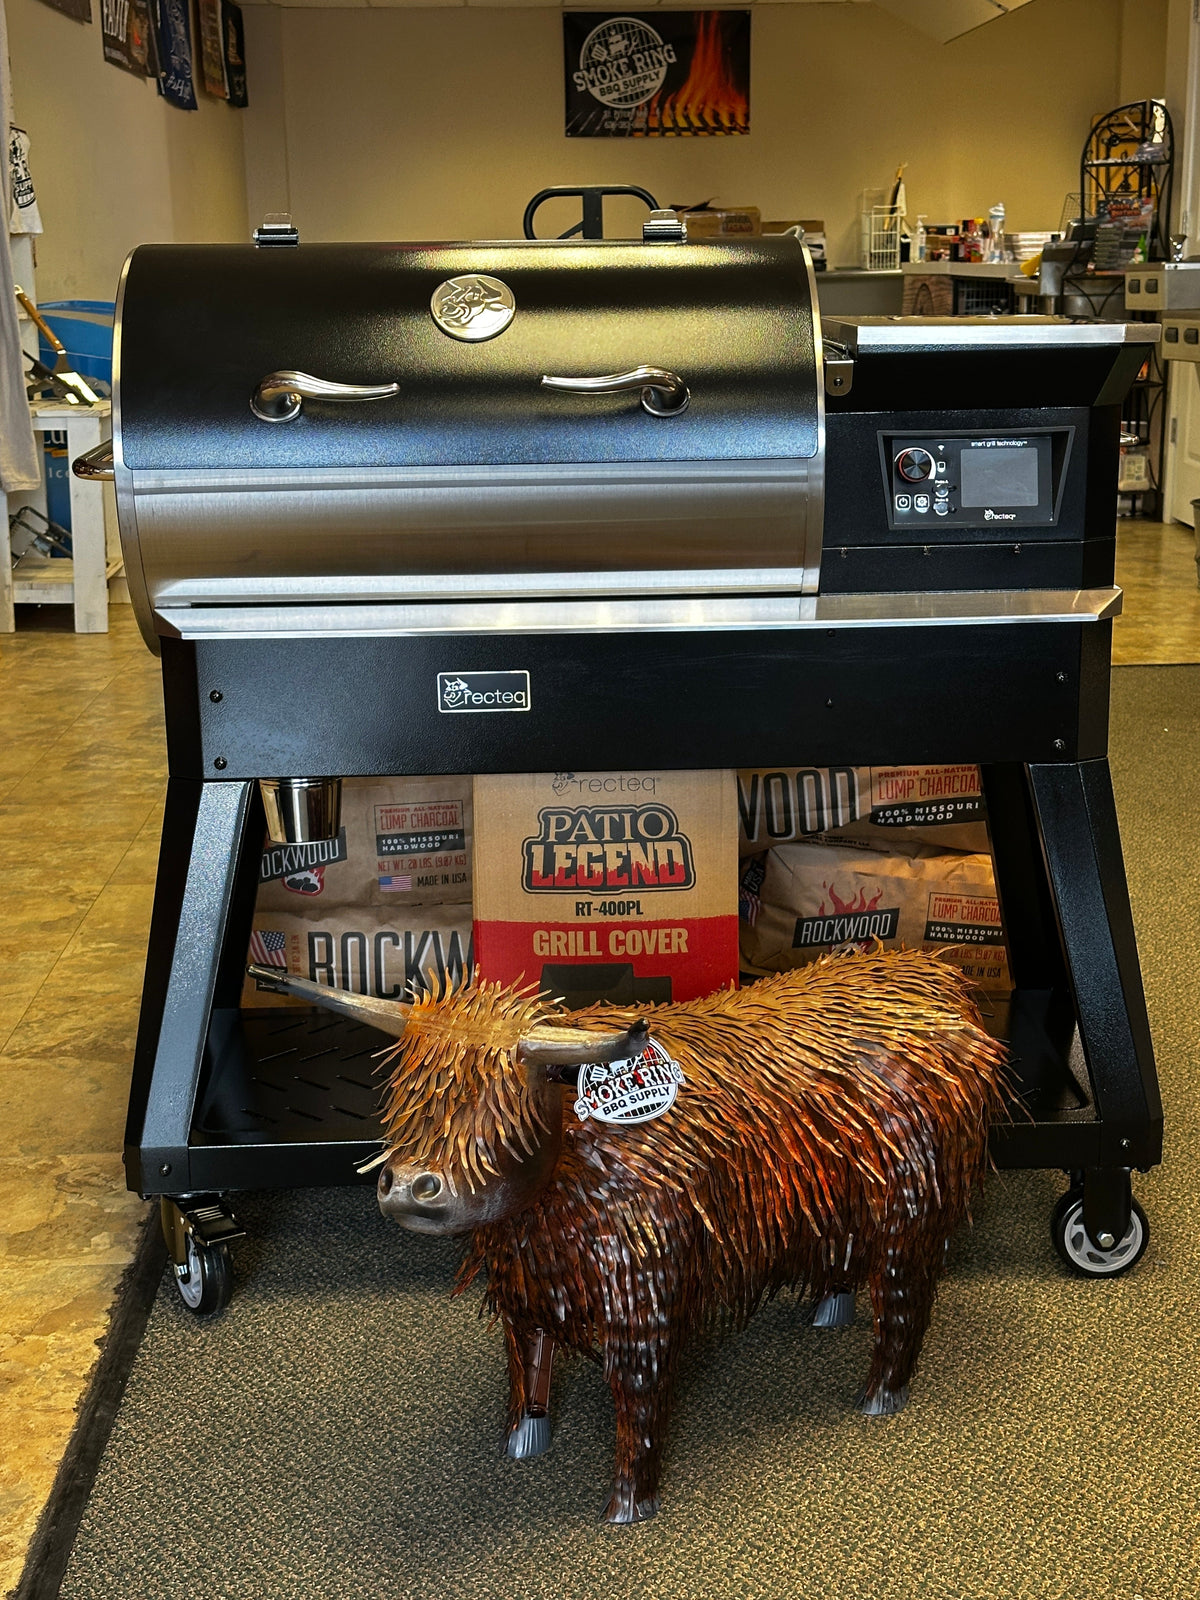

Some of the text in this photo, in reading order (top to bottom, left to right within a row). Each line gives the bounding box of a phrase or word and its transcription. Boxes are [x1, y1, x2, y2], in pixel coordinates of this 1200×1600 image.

[573, 43, 677, 92] SMOKE RING
[599, 70, 661, 97] BBQ SUPPLY
[986, 440, 996, 448] grill
[464, 689, 526, 707] recteq
[878, 769, 920, 778] PREMIUM
[878, 778, 915, 801] LUMP
[413, 804, 458, 812] ALL-NATURAL
[877, 801, 979, 818] 100% MISSOURI
[380, 810, 460, 830] LUMP CHARCOAL
[546, 811, 670, 842] PATIO
[382, 841, 441, 852] HARDWOOD
[409, 833, 459, 843] MISSOURI
[377, 860, 390, 872] NET
[408, 858, 417, 870] 20
[531, 840, 686, 887] LEGEND
[417, 872, 467, 888] MADE IN USA
[575, 900, 644, 917] RT-400PL
[934, 896, 962, 904] PREMIUM
[932, 902, 958, 919] LUMP
[800, 913, 891, 944] ROCKWOOD
[929, 931, 985, 941] HARDWOOD
[957, 927, 1003, 936] MISSOURI
[533, 928, 689, 957] GRILL COVER
[976, 966, 986, 977] IN
[986, 967, 1002, 978] USA
[573, 1060, 686, 1121] SMOKE RING
[602, 1086, 671, 1115] BBQ SUPPLY
